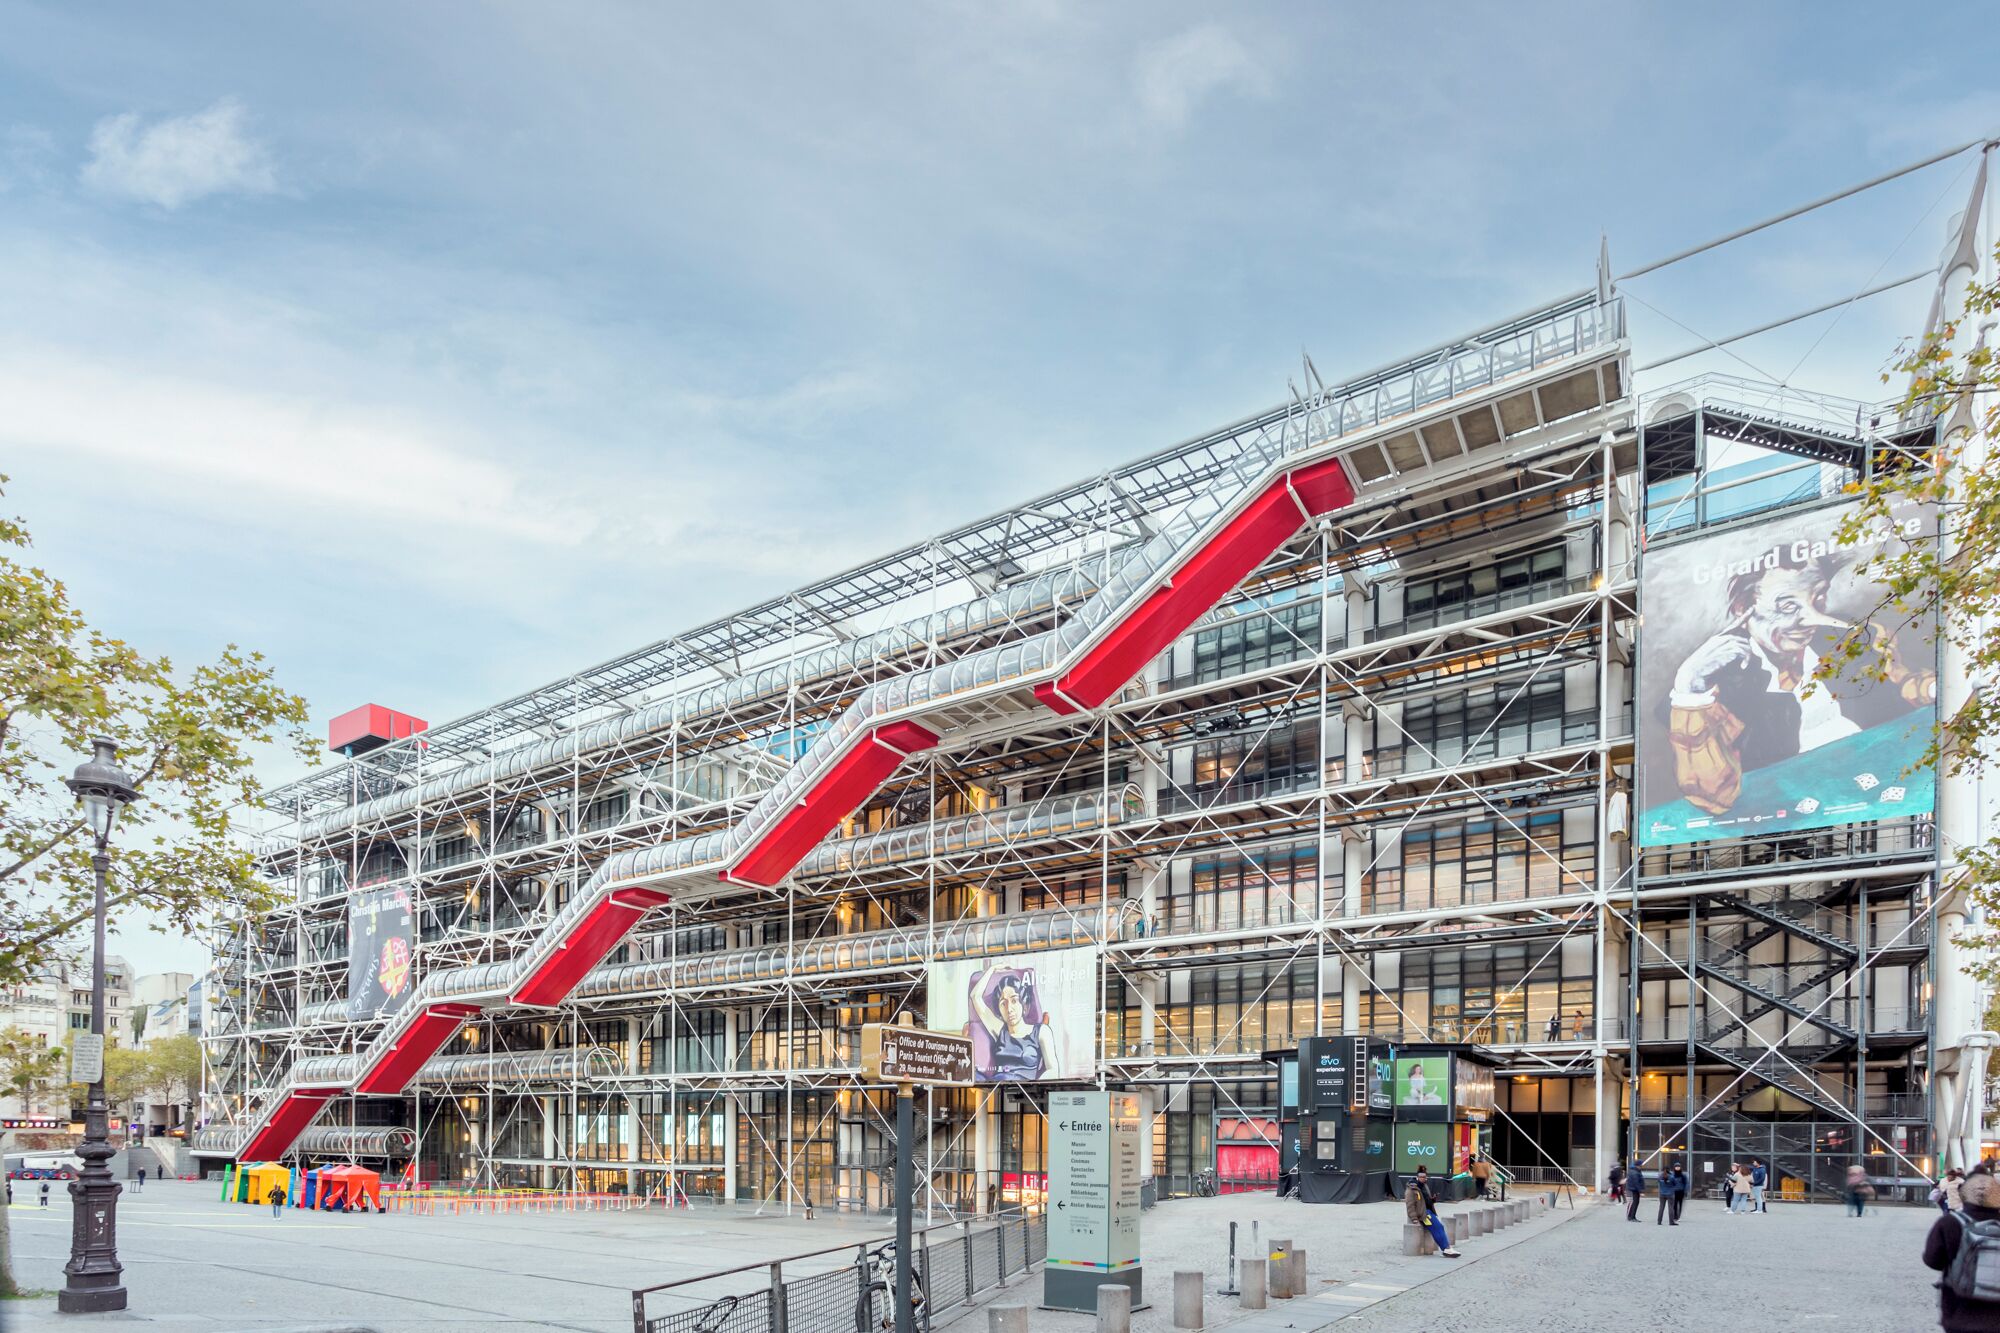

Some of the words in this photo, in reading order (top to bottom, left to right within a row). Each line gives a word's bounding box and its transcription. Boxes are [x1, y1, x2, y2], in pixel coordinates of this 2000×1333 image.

[899, 1036, 916, 1047] Office
[925, 1040, 948, 1052] Tourisme
[949, 1044, 955, 1052] de
[955, 1044, 968, 1054] Paris
[899, 1050, 913, 1061] Paris
[914, 1052, 933, 1063] Tourist
[1320, 1058, 1340, 1066] evo
[907, 1064, 916, 1073] Rue
[923, 1066, 936, 1074] Rivoli
[1376, 1063, 1391, 1081] evo
[1071, 1120, 1102, 1132] Entrée
[1407, 1145, 1436, 1156] evo
